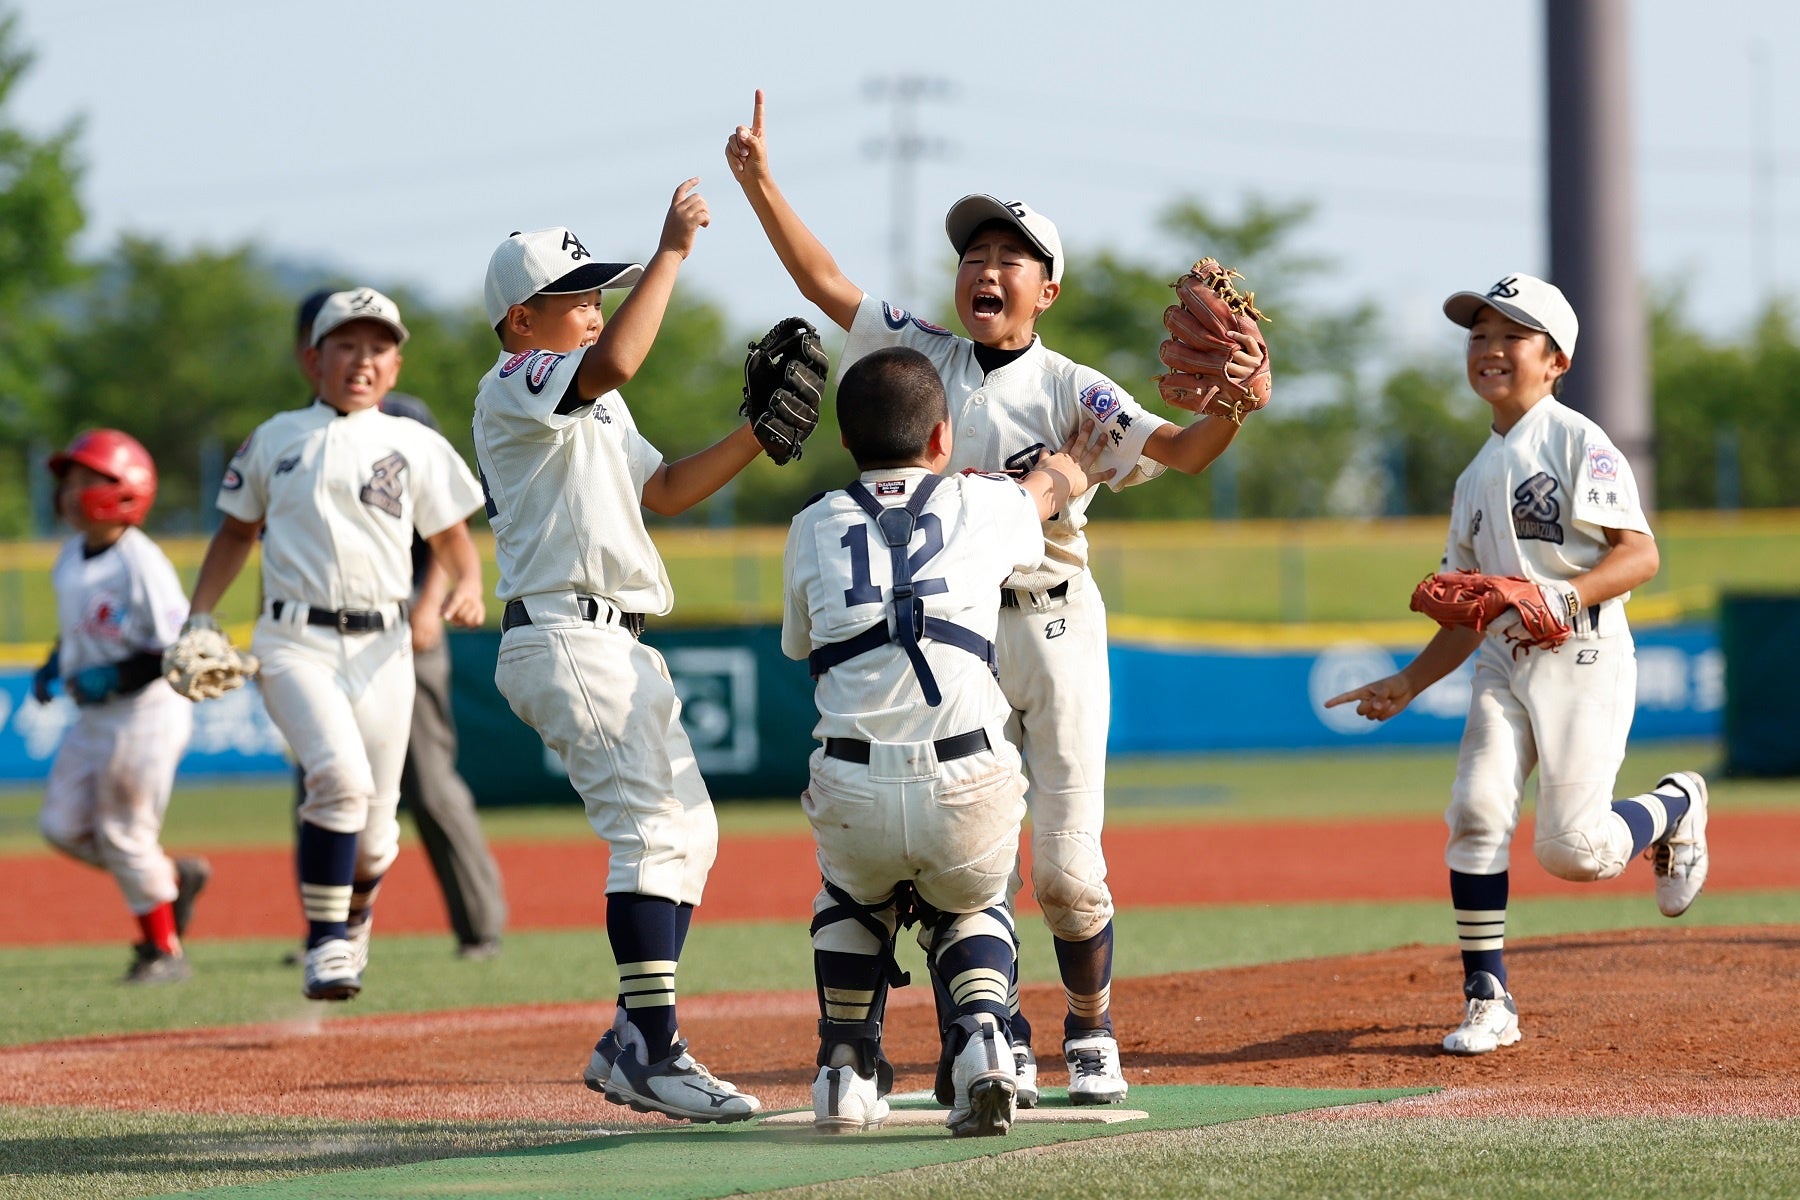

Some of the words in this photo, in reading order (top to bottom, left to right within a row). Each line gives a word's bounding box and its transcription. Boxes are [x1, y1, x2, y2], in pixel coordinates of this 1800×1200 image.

[533, 365, 545, 384] Since
[1109, 411, 1133, 447] 兵庫
[1587, 488, 1618, 507] 兵庫
[840, 512, 949, 608] 12
